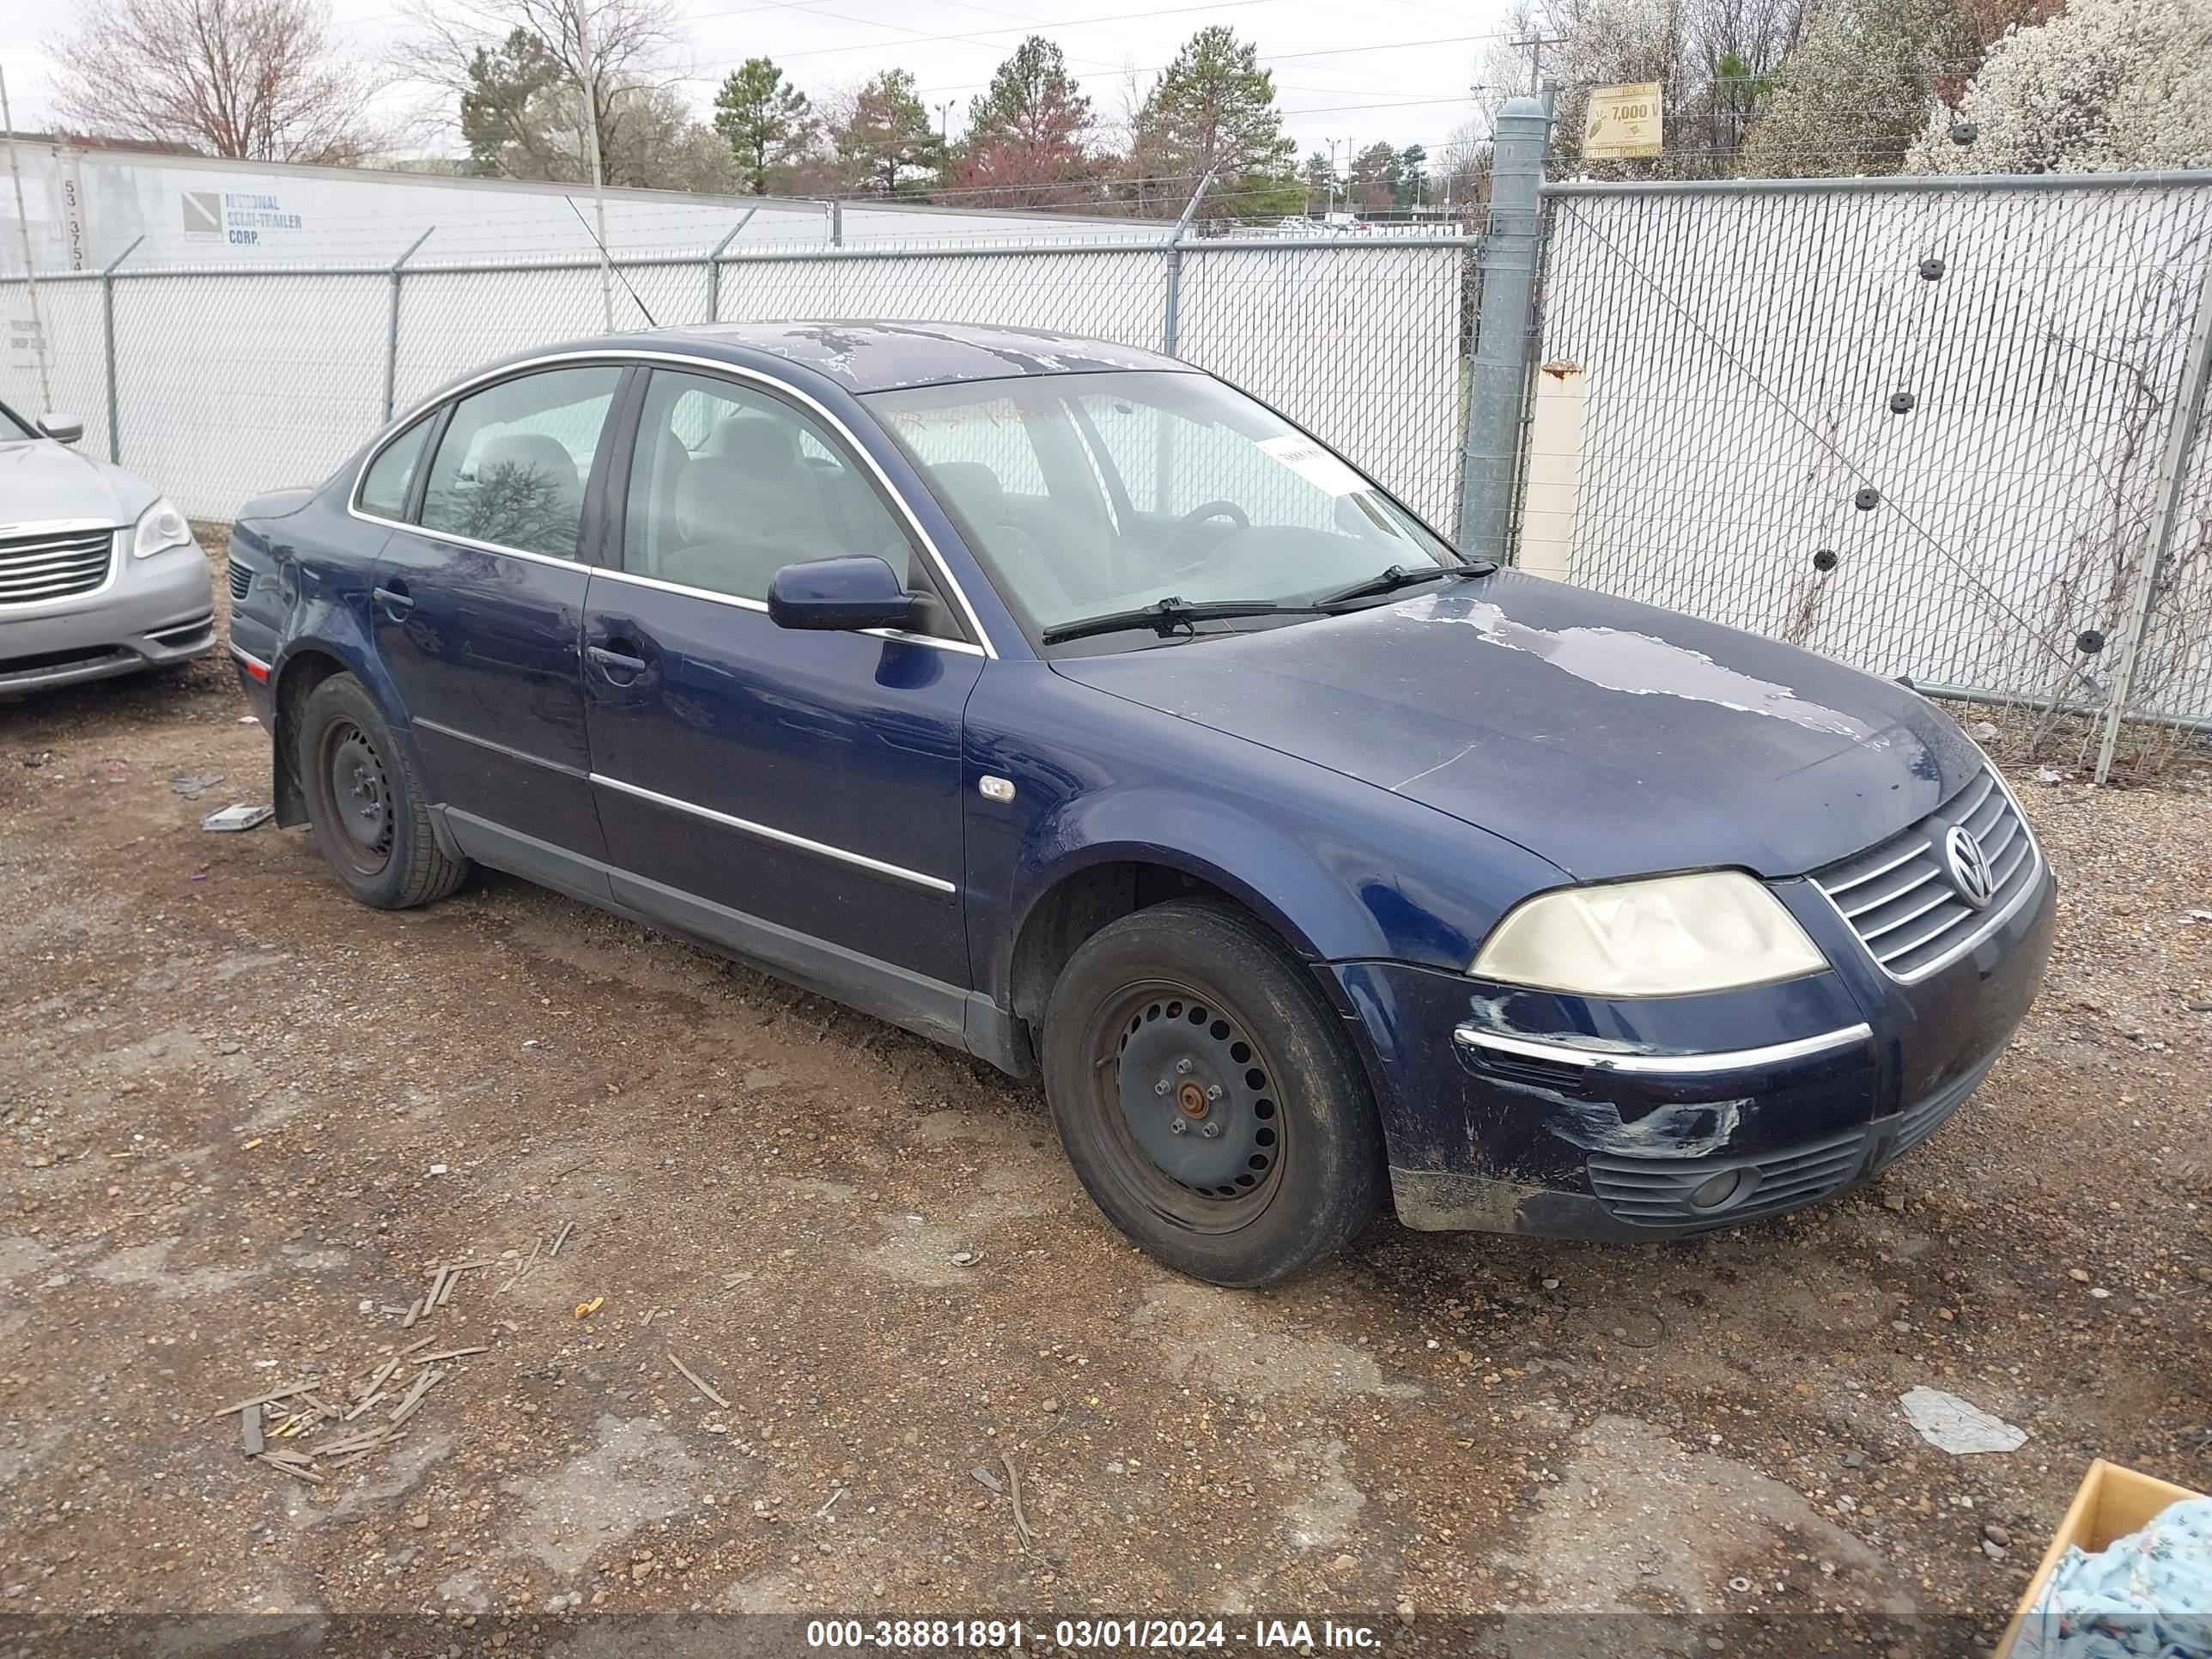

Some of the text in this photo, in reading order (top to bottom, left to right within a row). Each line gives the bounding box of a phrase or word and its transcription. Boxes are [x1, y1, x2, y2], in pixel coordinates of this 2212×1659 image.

[1613, 104, 1647, 123] 7,000
[226, 193, 279, 210] NATIONAL
[228, 211, 301, 228] SEMI-TRAILER
[229, 229, 260, 246] CORP.
